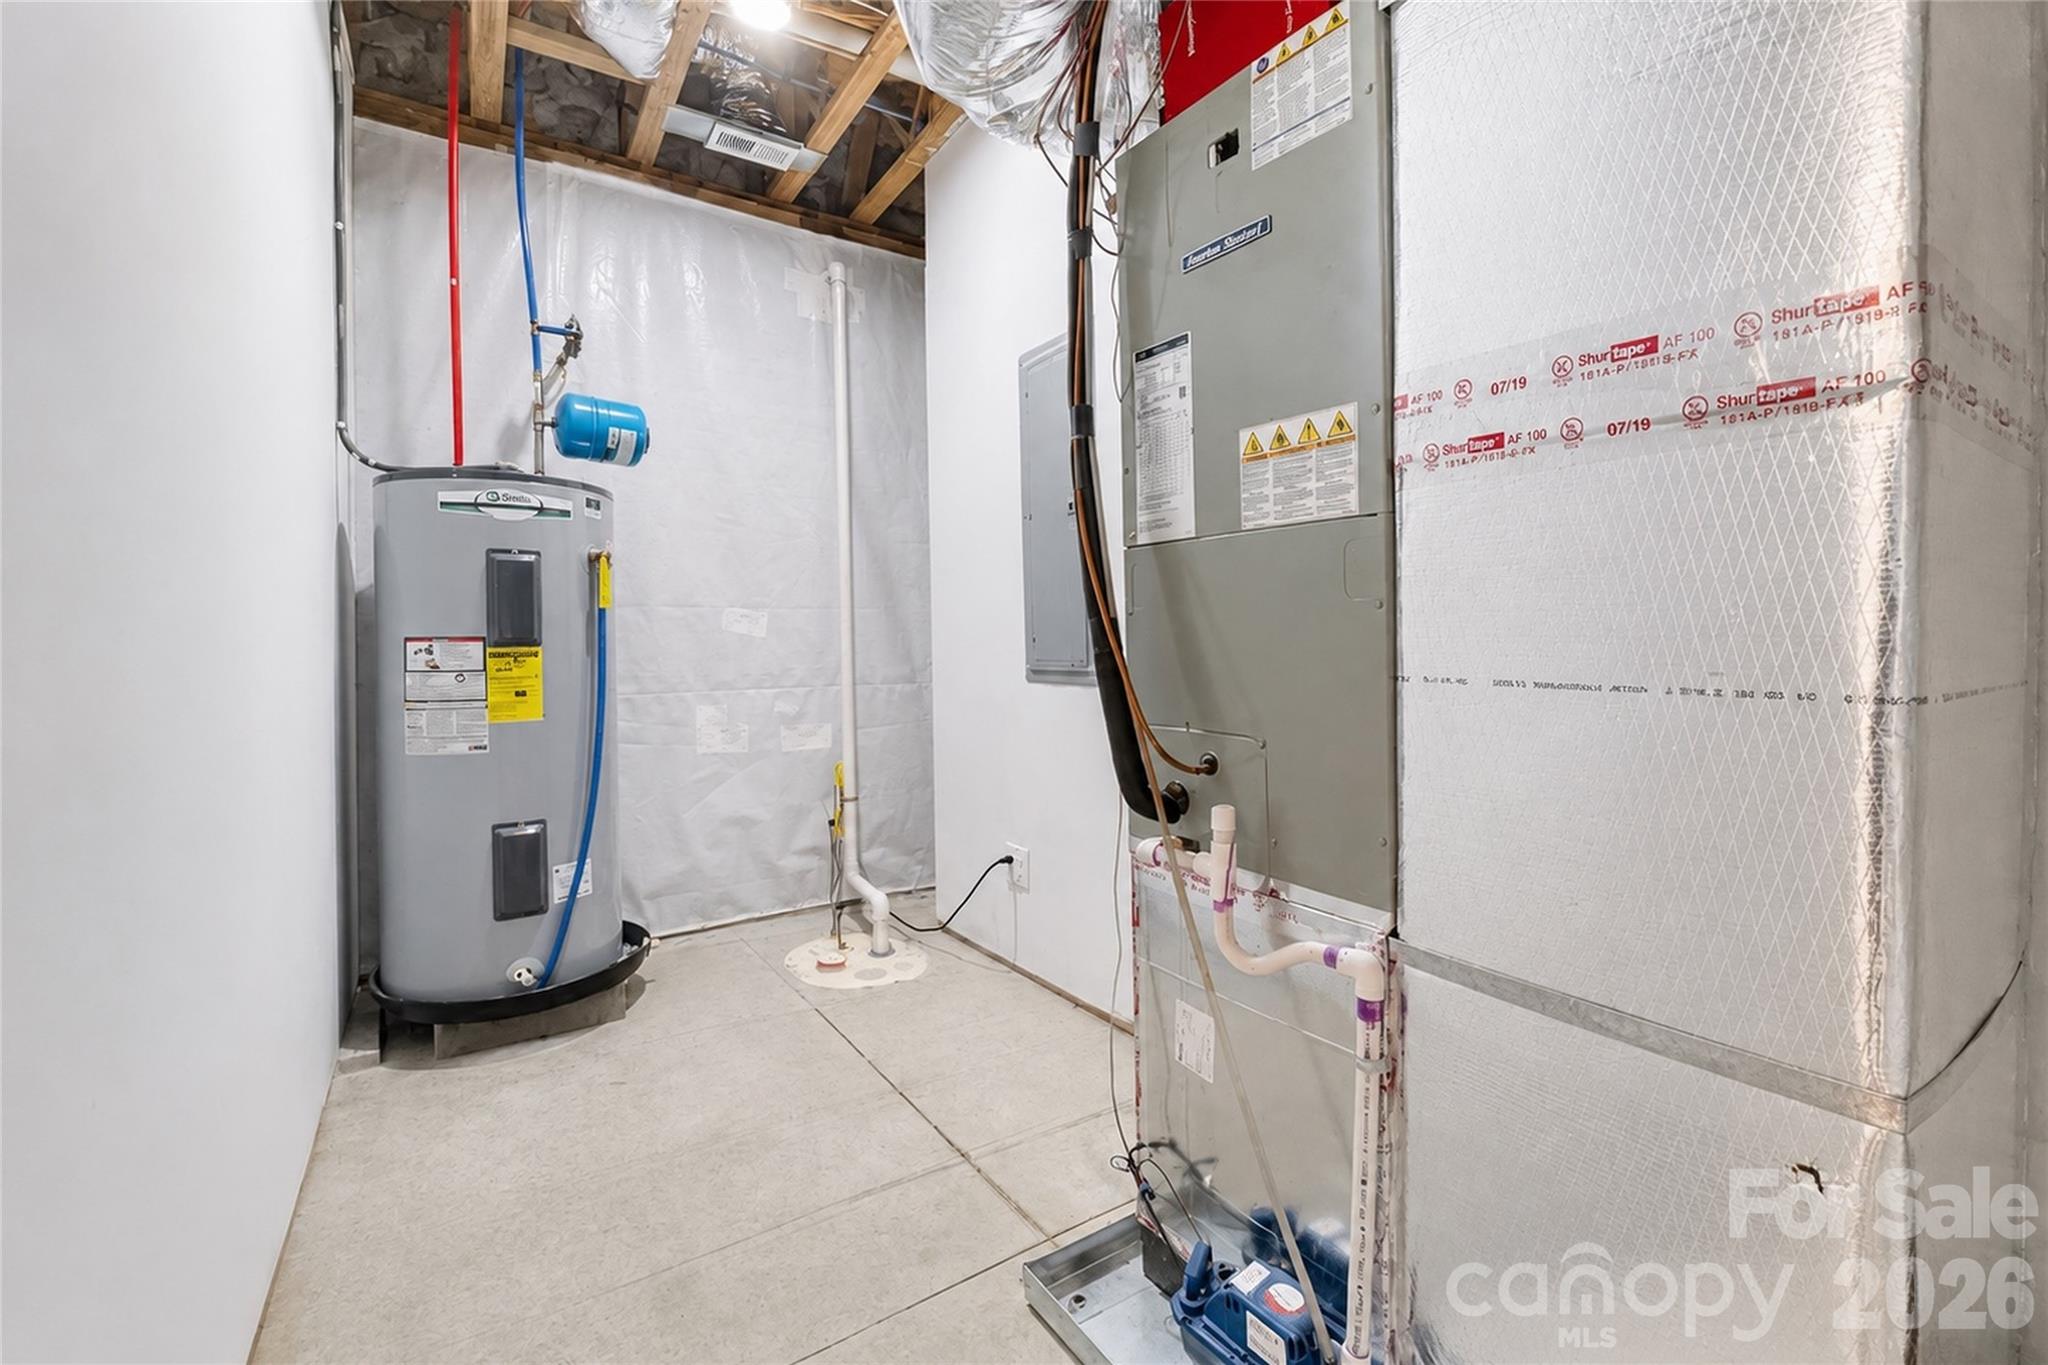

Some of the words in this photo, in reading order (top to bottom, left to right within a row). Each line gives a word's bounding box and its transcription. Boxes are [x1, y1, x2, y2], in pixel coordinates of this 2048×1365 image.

[1886, 282, 1914, 301] AF
[1578, 335, 1659, 367] Shurtape
[1663, 334, 1683, 351] AF
[1690, 327, 1715, 343] 100
[1490, 376, 1527, 396] 07/19
[1716, 377, 1816, 411] Shurtape
[1821, 376, 1848, 394] AF
[1854, 370, 1887, 387] 100
[1507, 433, 1523, 445] AF
[1527, 428, 1548, 441] 100
[1606, 417, 1651, 437] 07/19
